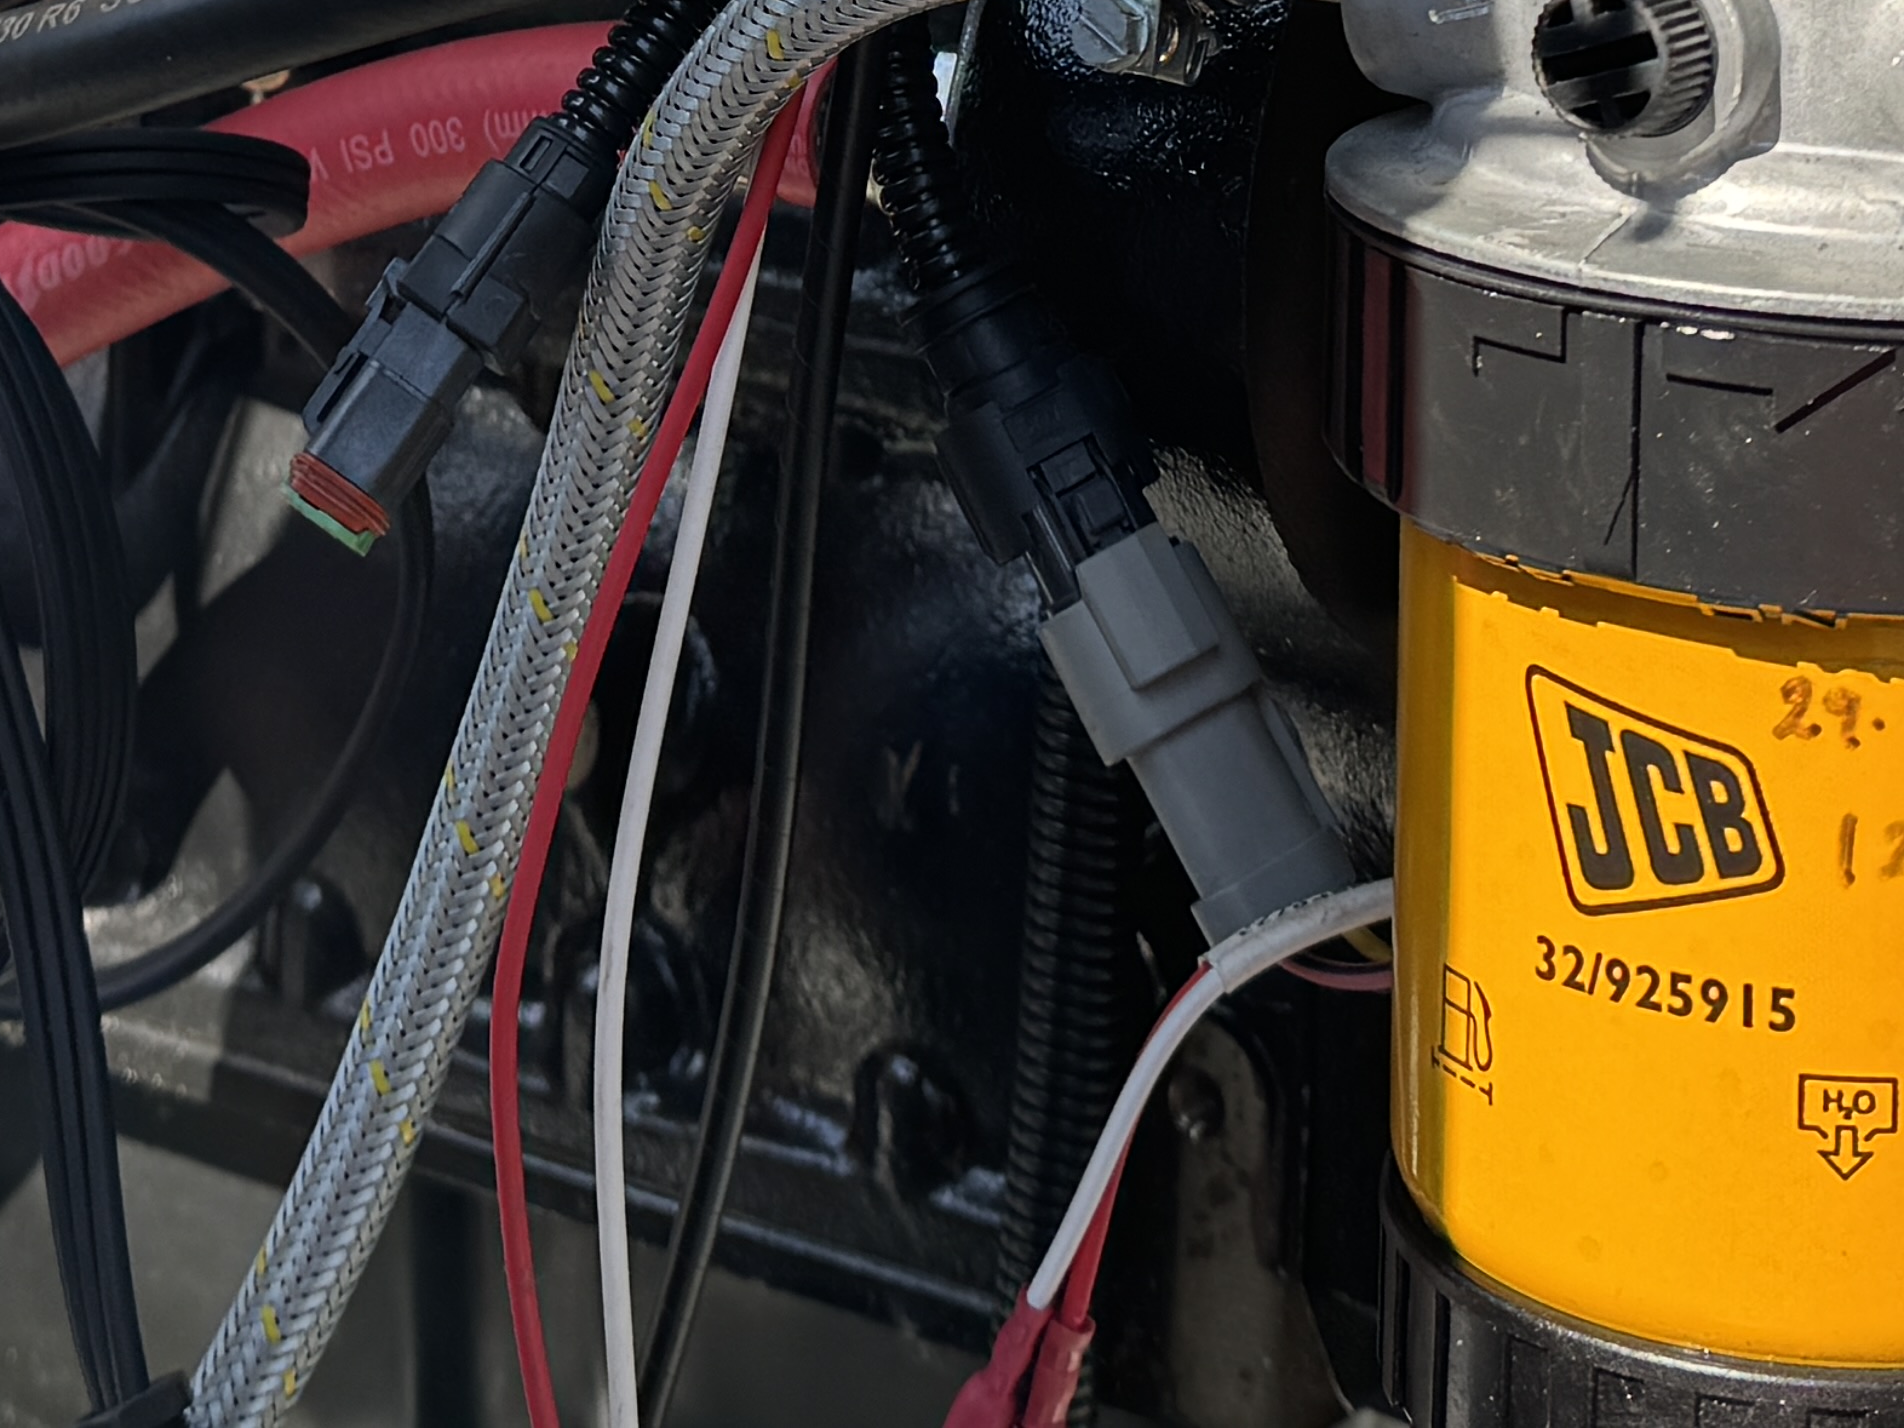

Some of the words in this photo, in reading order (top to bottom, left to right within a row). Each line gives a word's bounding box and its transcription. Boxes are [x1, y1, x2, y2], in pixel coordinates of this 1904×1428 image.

[339, 128, 395, 174] PSI
[409, 116, 467, 159] 300
[1564, 701, 1763, 891] JCB
[1534, 934, 1797, 1033] 32/925915
